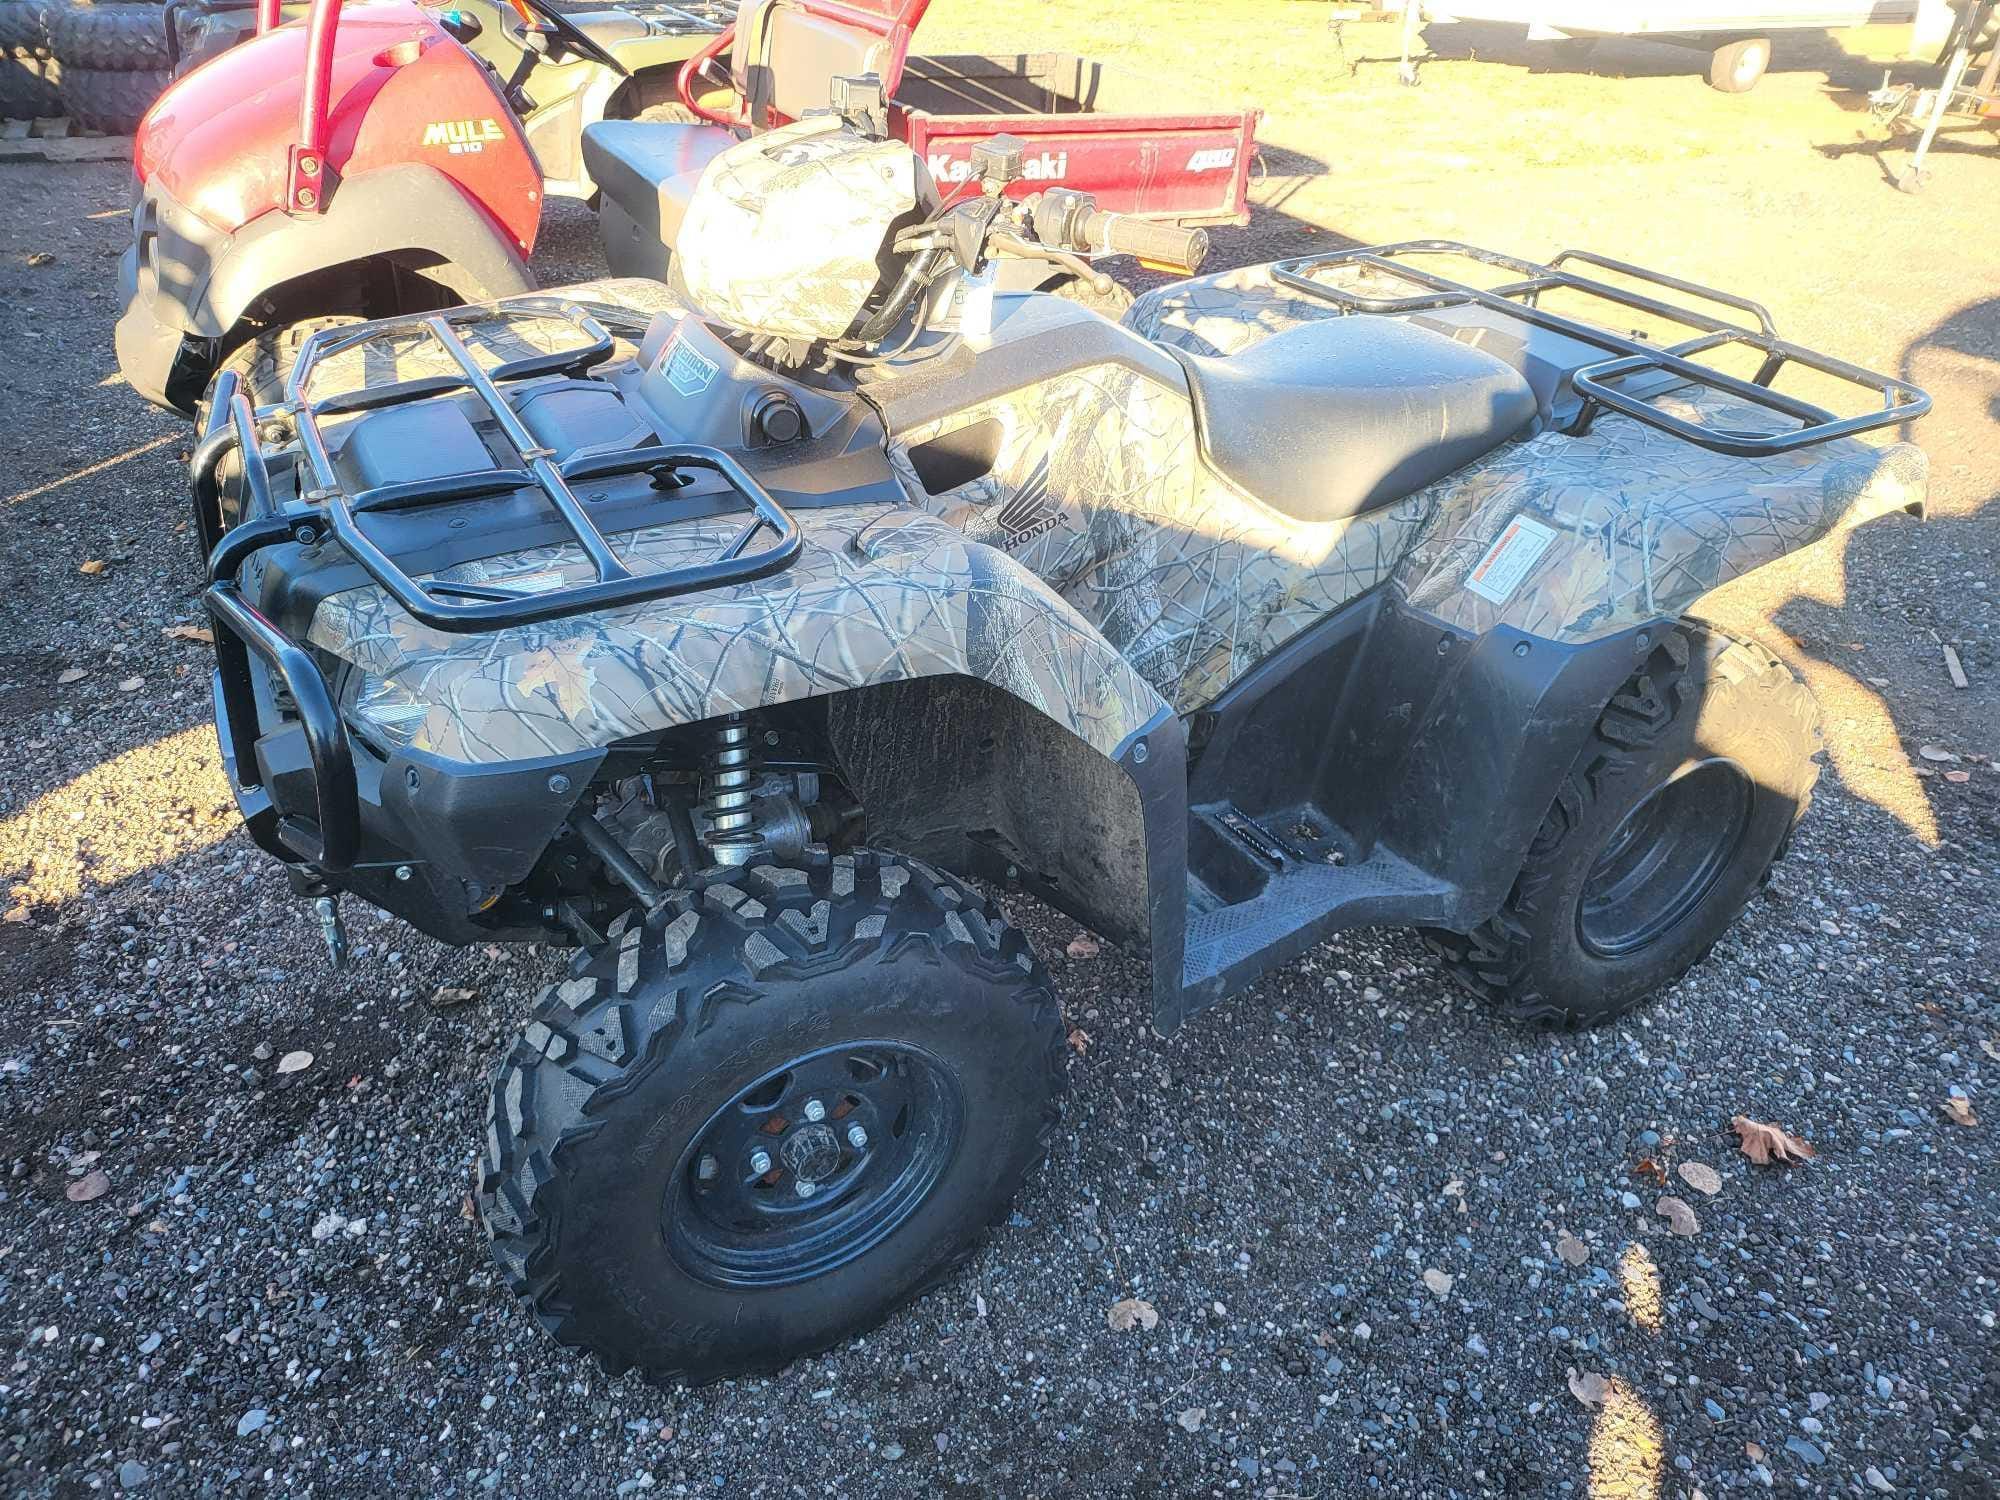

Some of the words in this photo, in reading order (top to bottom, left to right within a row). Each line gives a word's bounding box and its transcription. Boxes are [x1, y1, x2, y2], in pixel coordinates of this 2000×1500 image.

[422, 119, 505, 145] MULE
[927, 152, 1067, 182] Kaaki
[1002, 512, 1069, 552] HONDA
